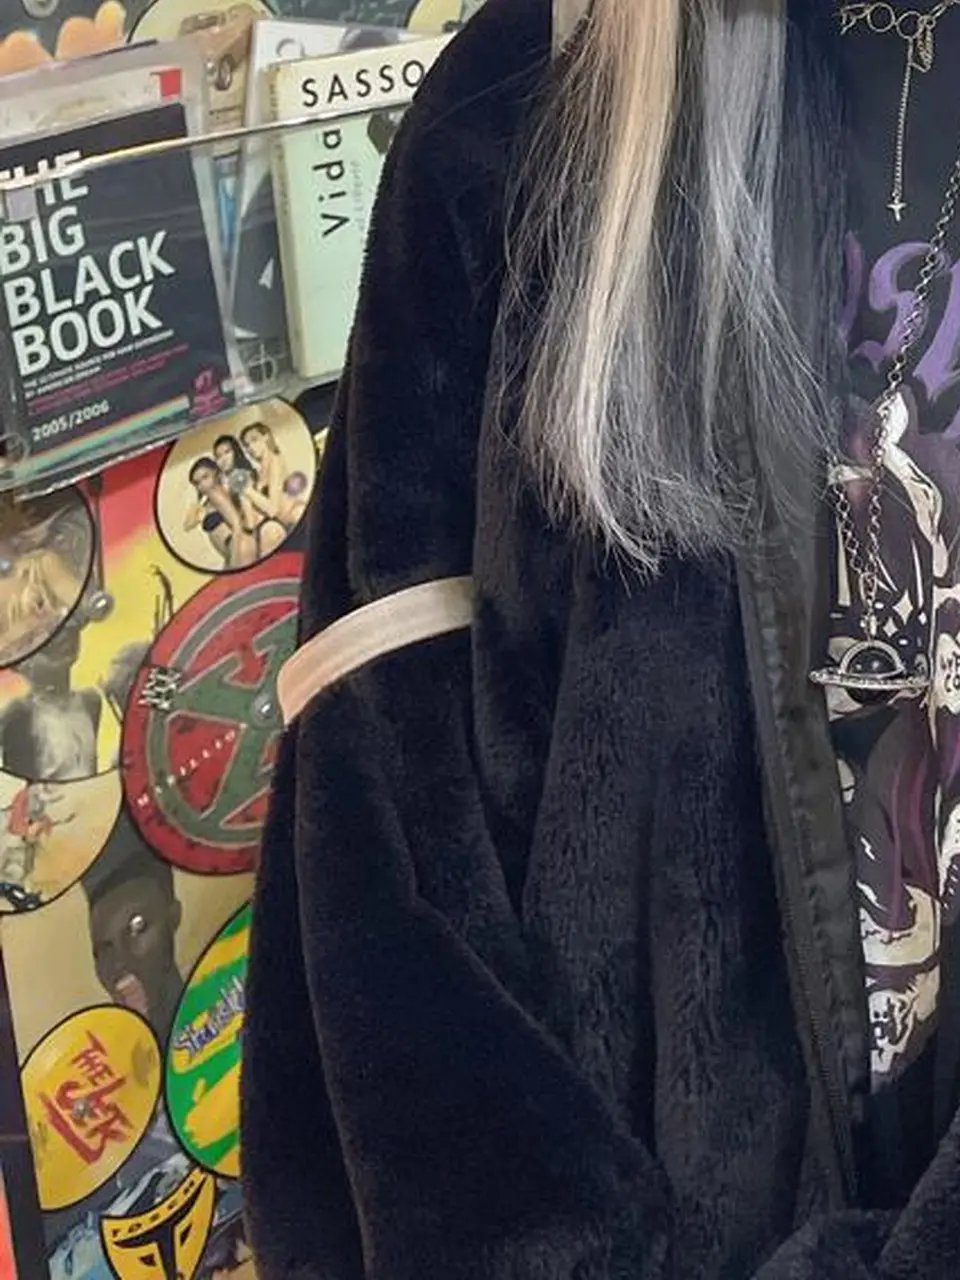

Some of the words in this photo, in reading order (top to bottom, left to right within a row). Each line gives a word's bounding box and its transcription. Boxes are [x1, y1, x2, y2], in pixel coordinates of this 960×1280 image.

[301, 60, 427, 108] SASSO
[312, 128, 350, 238] Vida
[0, 206, 85, 276] BIG
[3, 230, 176, 328] BLACK
[12, 284, 163, 377] BOOK
[31, 400, 110, 442] 2005/2006
